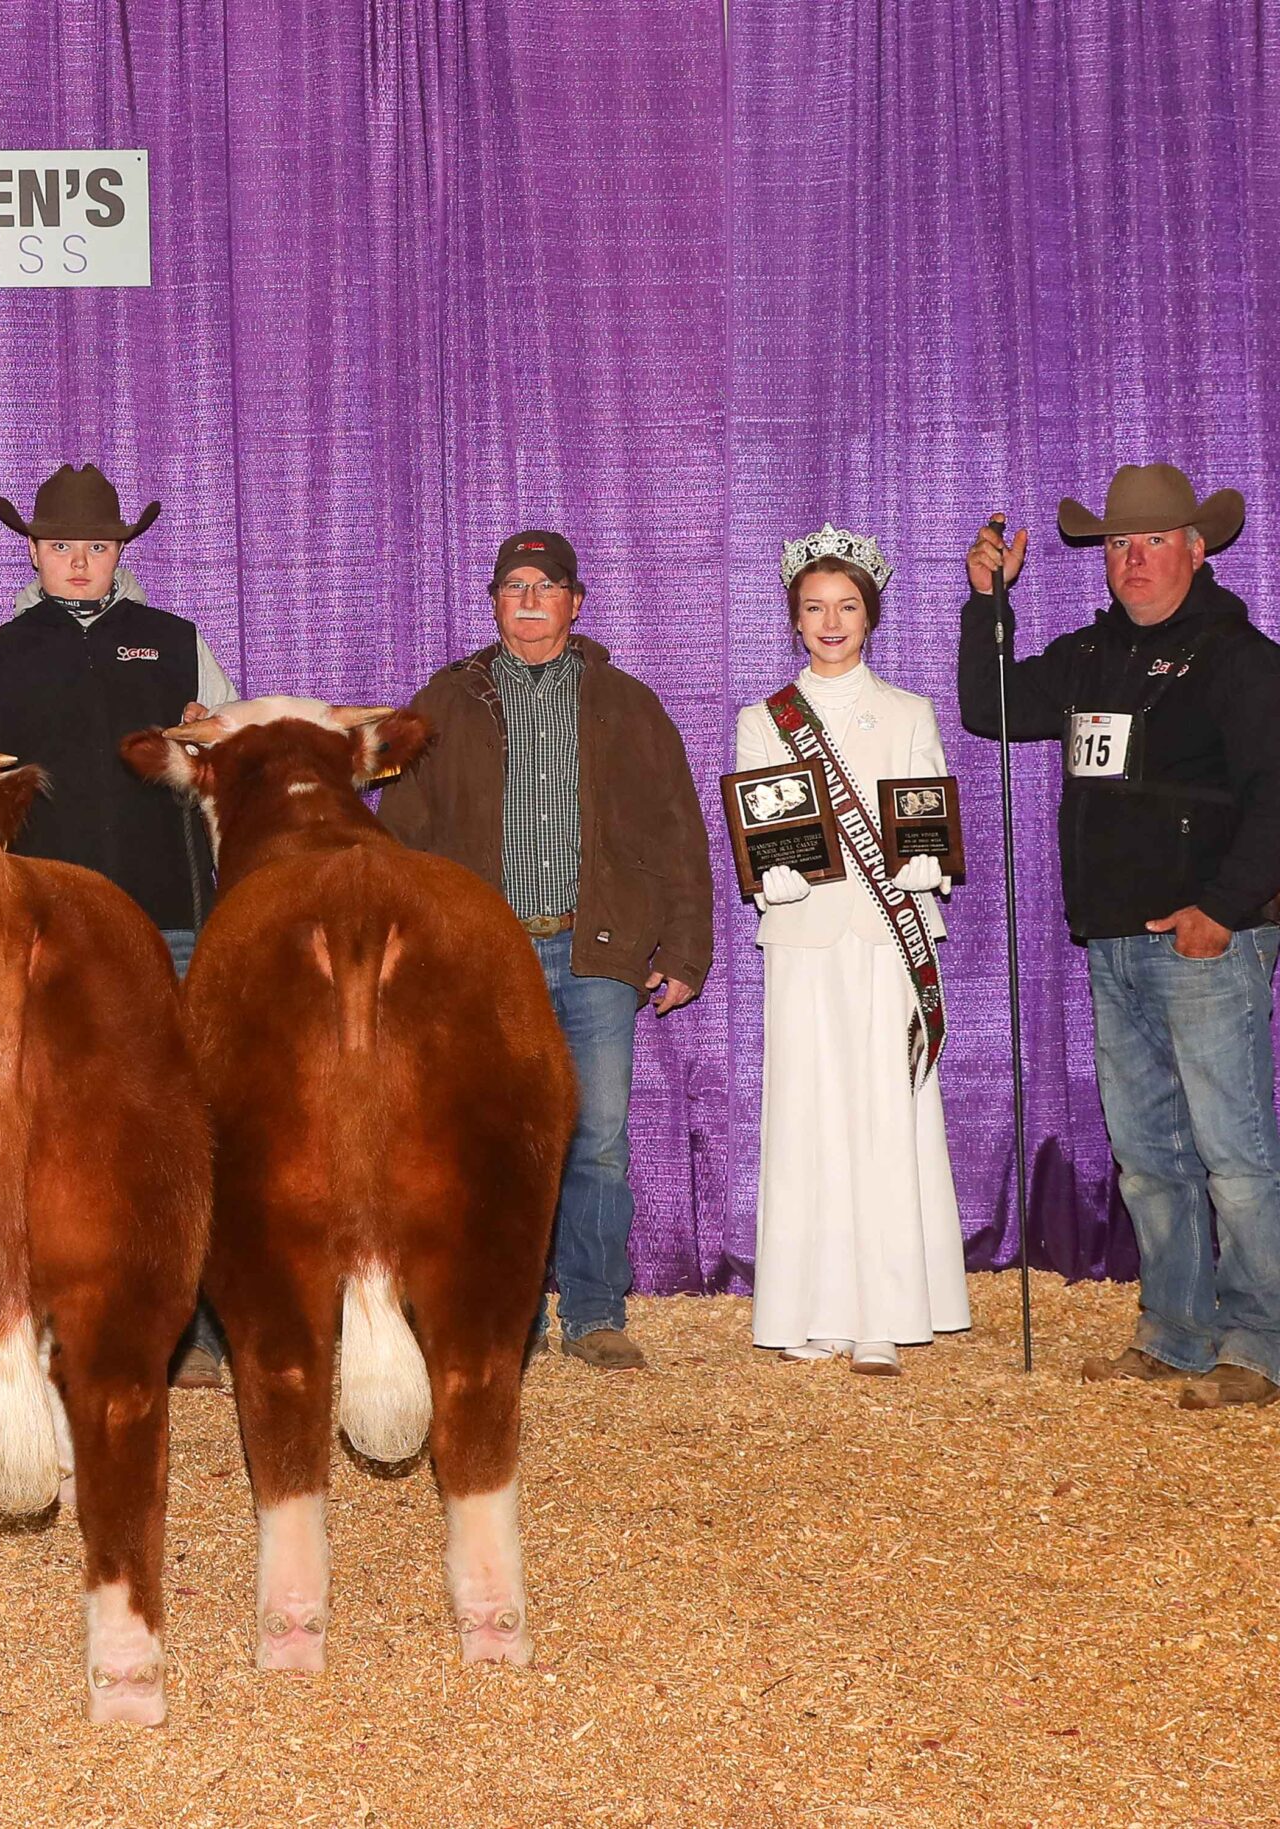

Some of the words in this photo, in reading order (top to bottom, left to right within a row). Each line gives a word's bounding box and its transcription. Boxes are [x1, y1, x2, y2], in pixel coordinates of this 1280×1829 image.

[1073, 734, 1111, 767] 315
[837, 807, 905, 906] HEREFORD
[896, 908, 929, 968] QUEEN
